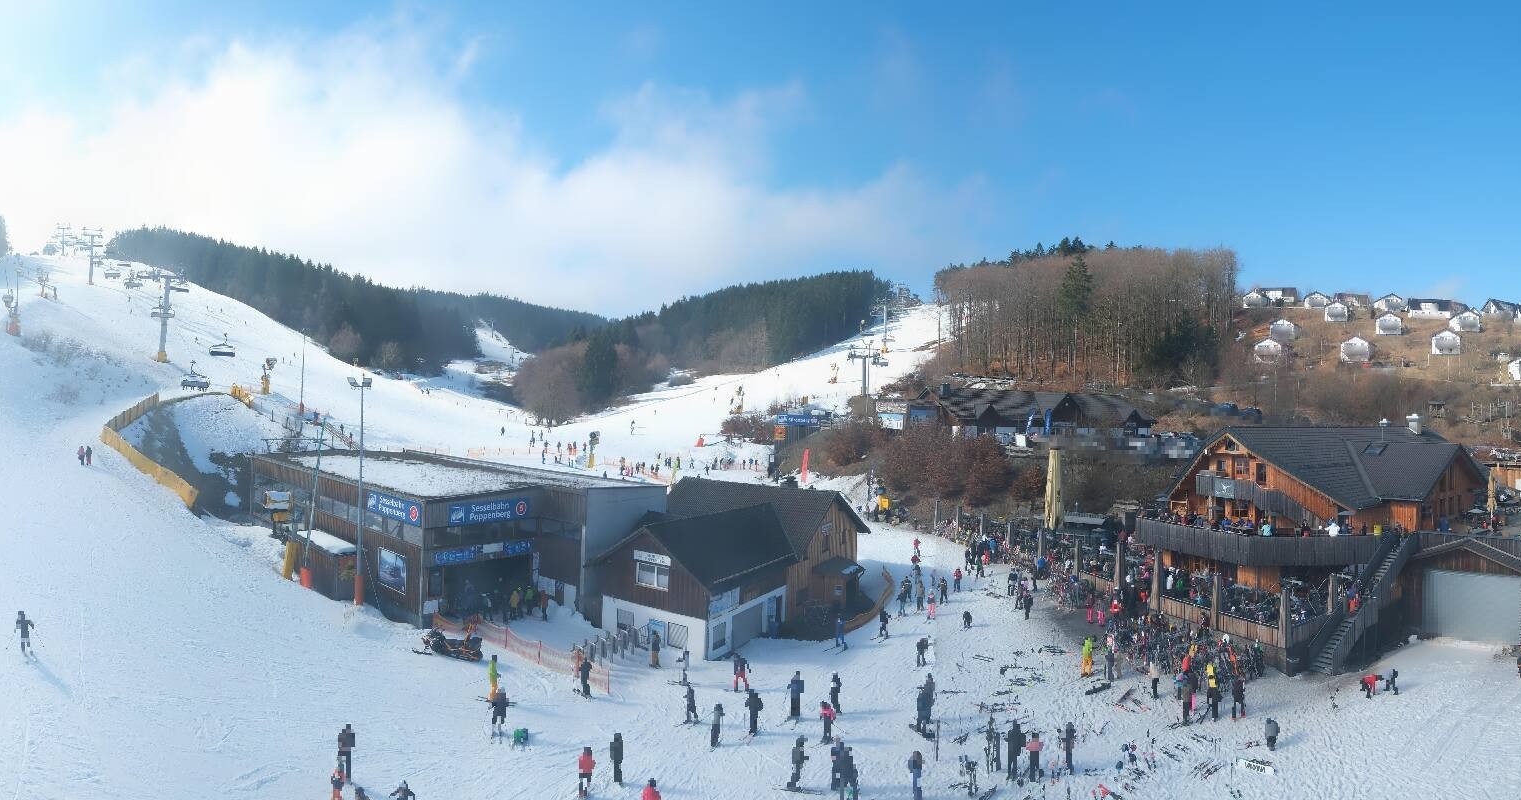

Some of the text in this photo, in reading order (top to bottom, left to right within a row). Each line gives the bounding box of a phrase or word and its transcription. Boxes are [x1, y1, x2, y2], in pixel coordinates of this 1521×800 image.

[378, 503, 406, 519] Poppenberg
[471, 502, 510, 512] Sesselbahn
[469, 510, 511, 522] Poppenberg
